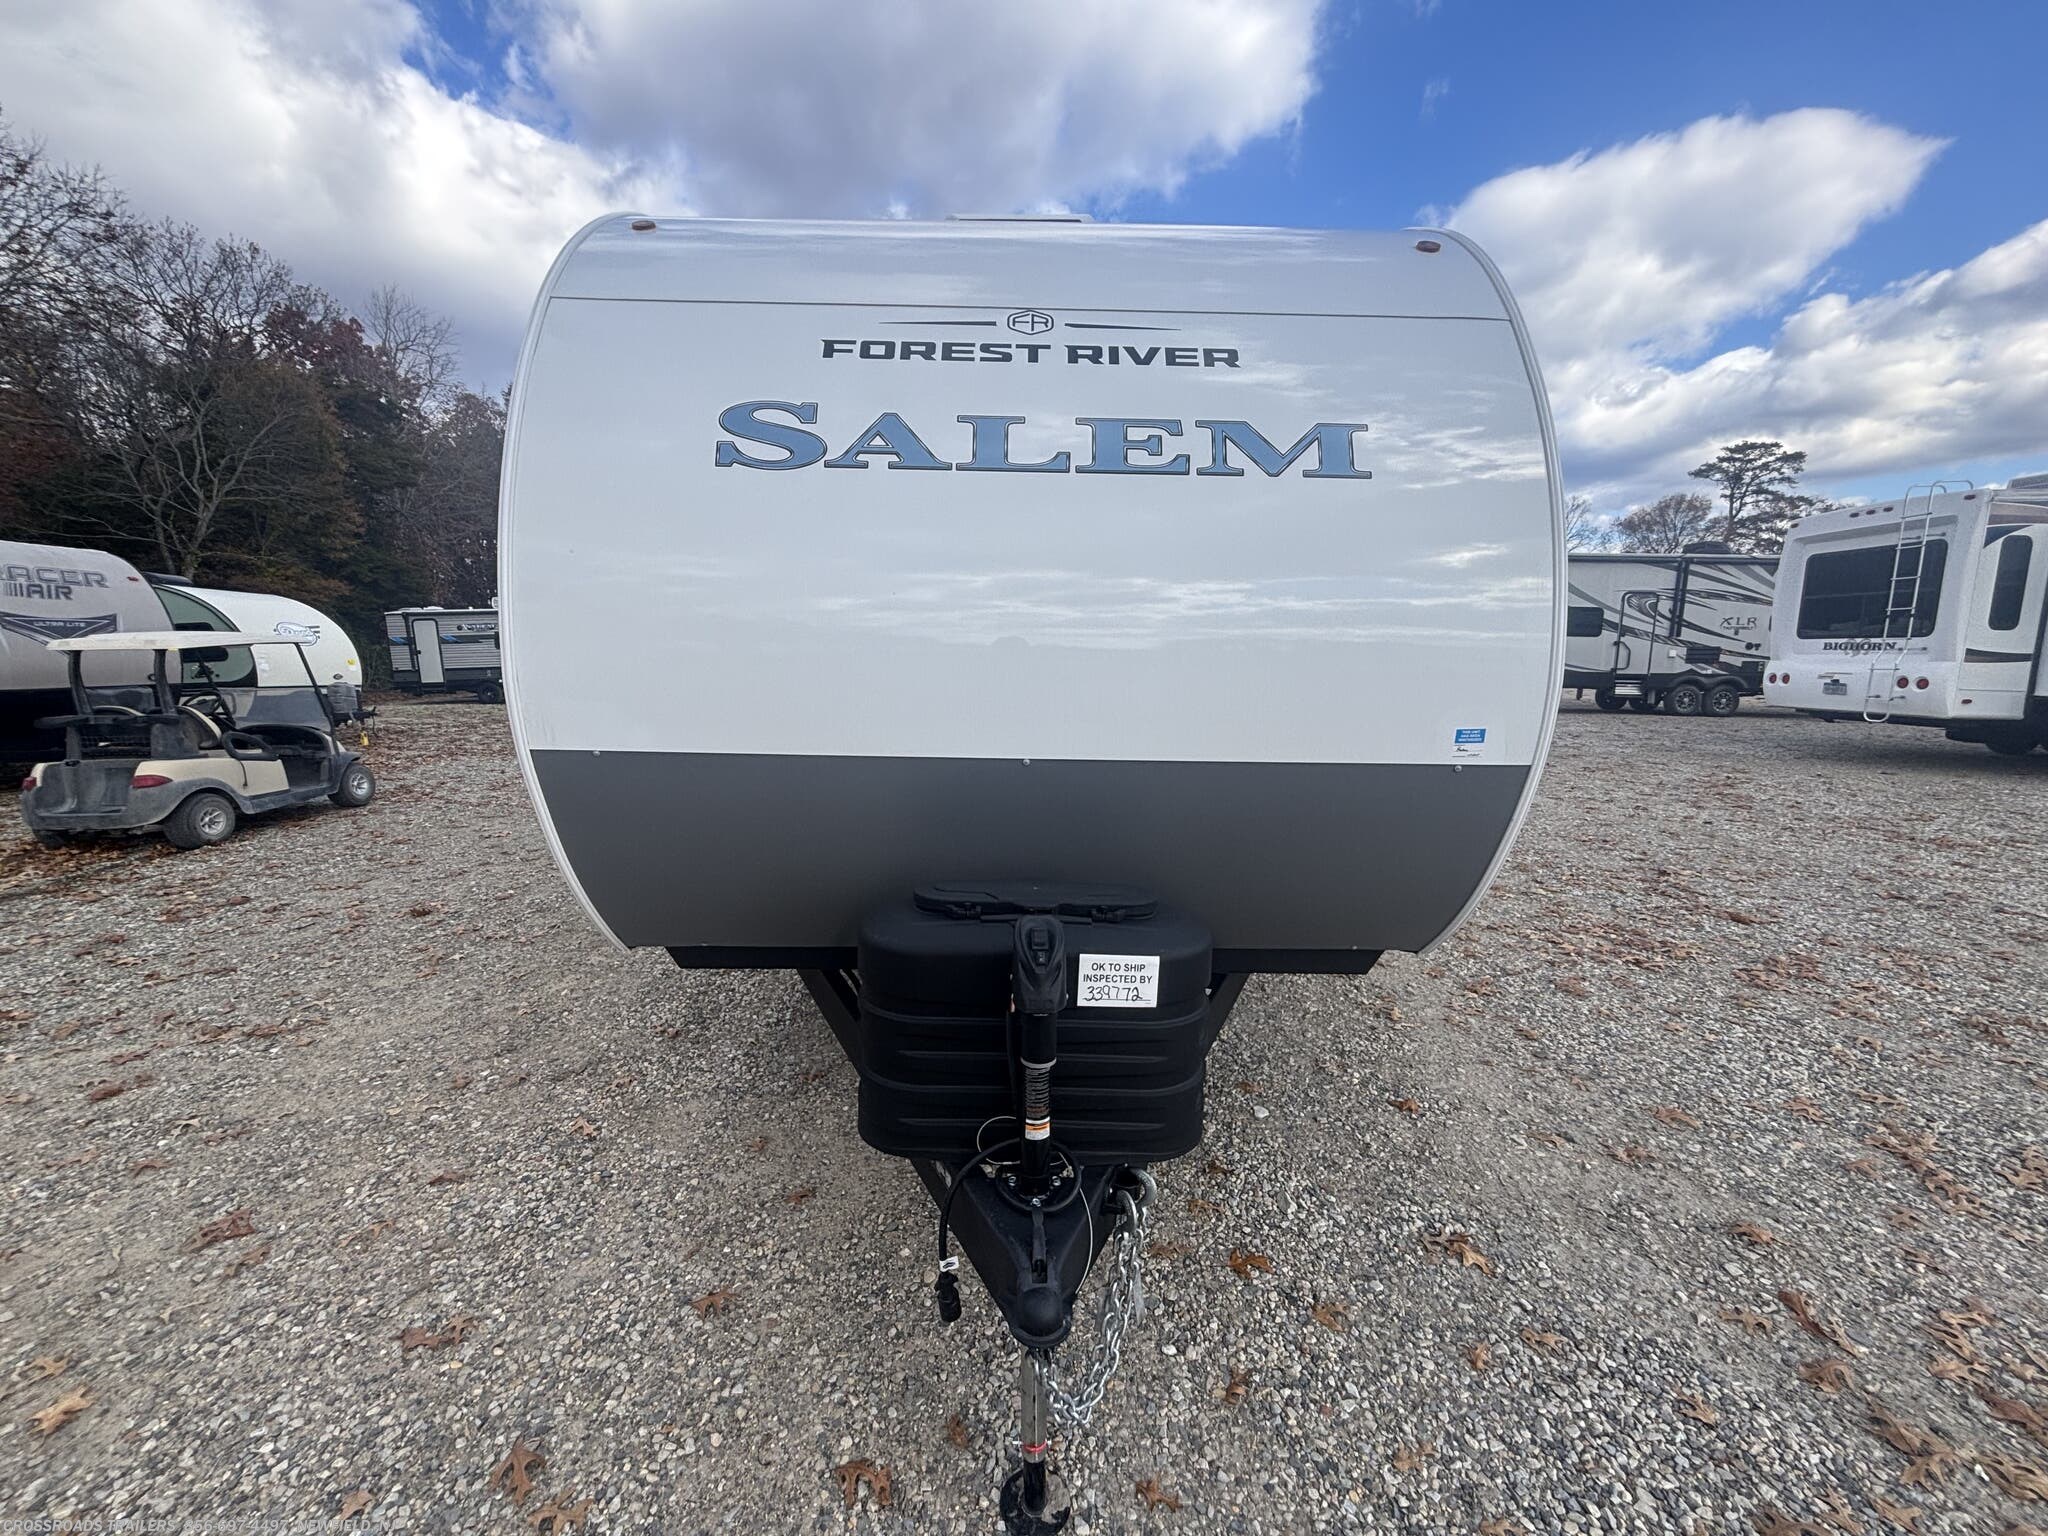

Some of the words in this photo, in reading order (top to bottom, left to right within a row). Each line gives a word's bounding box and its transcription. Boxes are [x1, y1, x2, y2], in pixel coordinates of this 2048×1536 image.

[820, 339, 1052, 364] FOREST
[1063, 343, 1242, 369] RIVER
[715, 400, 1373, 480] SALEM
[26, 583, 74, 601] AIR
[1720, 616, 1758, 629] XLR
[1823, 641, 1898, 652] BIGHORN
[1091, 962, 1106, 972] OK
[1109, 963, 1121, 972] TO
[1124, 964, 1146, 973] SHIP
[1083, 974, 1137, 984] INSPECTED
[1140, 975, 1153, 984] BY
[1083, 984, 1144, 1002] 339772
